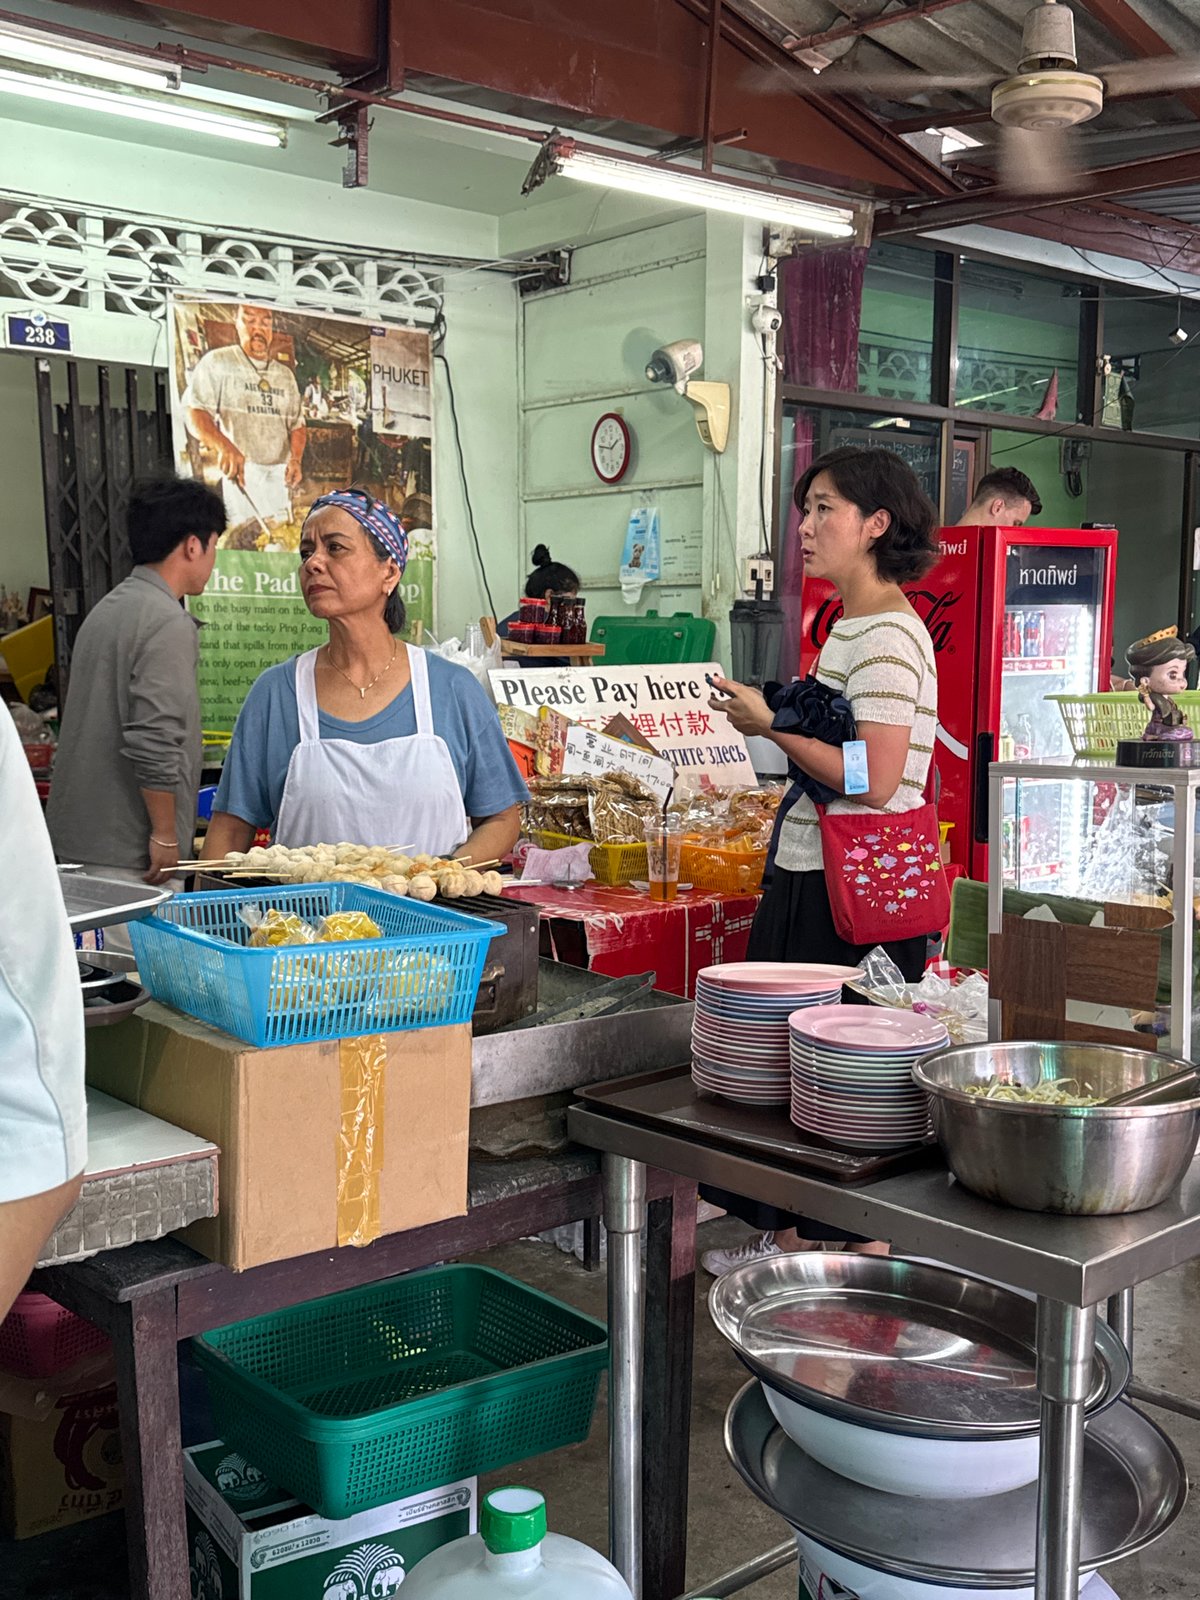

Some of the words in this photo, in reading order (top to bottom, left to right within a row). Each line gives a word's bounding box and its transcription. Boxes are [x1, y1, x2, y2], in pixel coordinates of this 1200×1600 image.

[25, 326, 56, 345] 238
[373, 363, 429, 386] PHUKET
[260, 393, 273, 406] 33
[254, 571, 297, 593] Pad
[1019, 564, 1078, 586] หาดทิพย์
[196, 602, 210, 613] On
[213, 602, 228, 613] the
[231, 603, 251, 615] busy
[254, 604, 276, 614] main
[293, 605, 306, 615] the
[223, 621, 232, 632] of
[236, 621, 250, 632] the
[254, 622, 276, 634] tacky
[279, 623, 298, 635] Ping
[301, 623, 323, 635] Pong
[223, 640, 240, 650] that
[243, 641, 265, 652] spills
[268, 640, 288, 650] from
[291, 641, 305, 651] the
[212, 658, 231, 669] only
[234, 660, 256, 670] open
[501, 678, 587, 707] Please
[590, 675, 639, 708] Pay
[645, 674, 701, 700] here
[660, 746, 705, 769] атите
[707, 743, 748, 766] здесь
